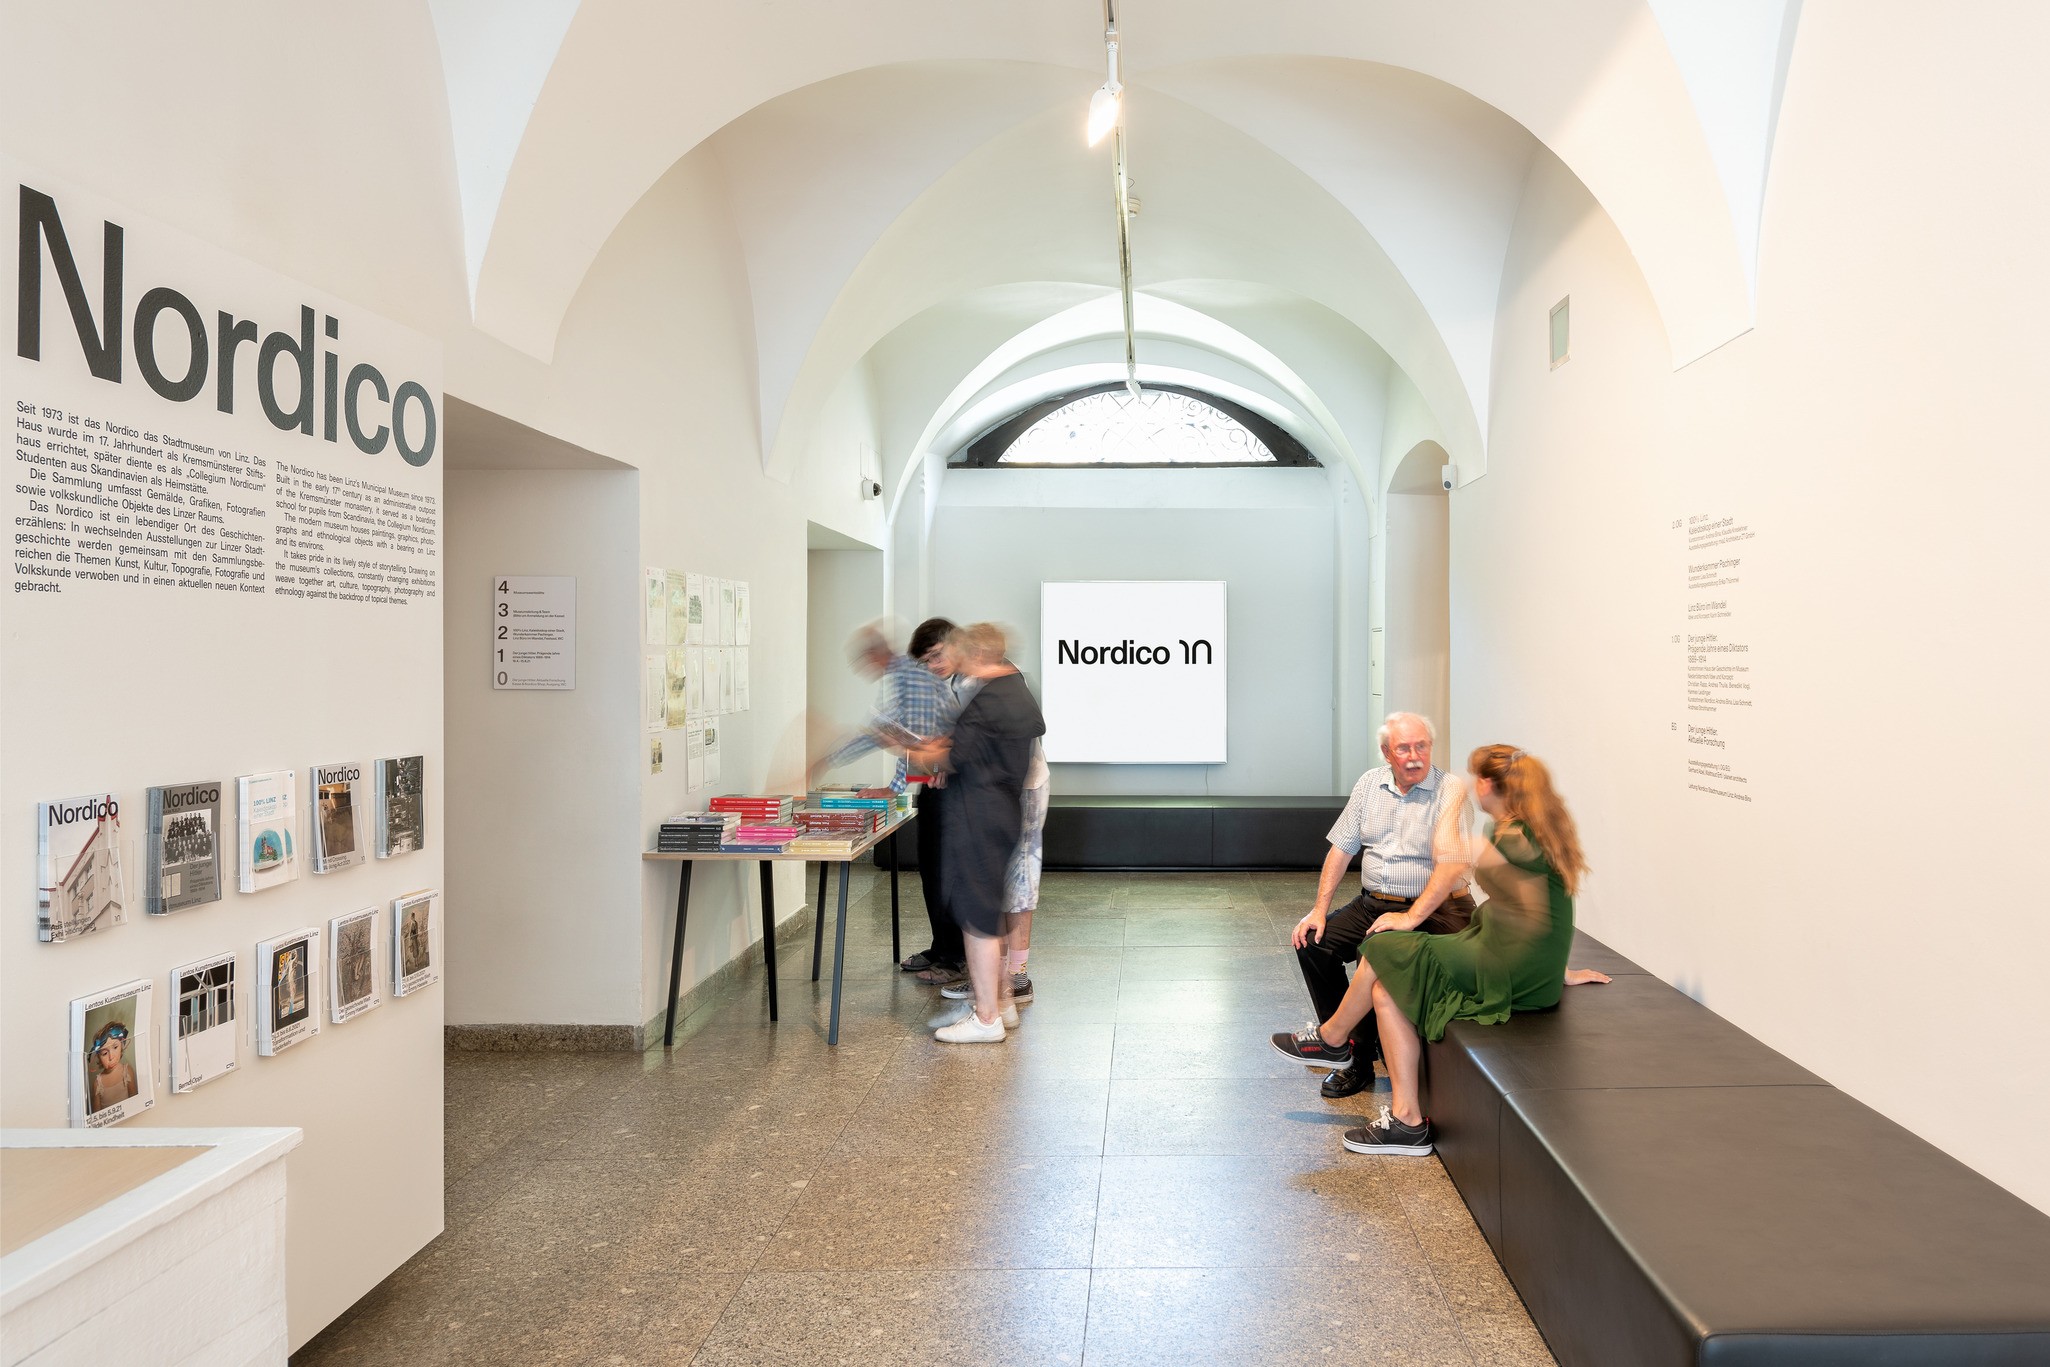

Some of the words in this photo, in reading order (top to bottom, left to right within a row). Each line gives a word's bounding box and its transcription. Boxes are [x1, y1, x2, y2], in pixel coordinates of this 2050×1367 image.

[17, 183, 437, 467] Nordico
[16, 400, 36, 416] Seit
[41, 407, 63, 422] 1973
[68, 412, 80, 426] ist
[84, 416, 101, 430] das
[105, 421, 140, 439] Nordico
[143, 430, 159, 443] das
[162, 434, 215, 456] Stadtmuseum
[218, 450, 232, 459] von
[234, 451, 250, 464] Linz.
[253, 455, 267, 468] Das
[16, 416, 43, 433] Haus
[47, 426, 78, 440] wurde
[82, 430, 94, 444] im
[98, 435, 110, 447] 17.
[113, 438, 164, 459] Jahrhundert
[166, 450, 179, 462] als
[182, 452, 243, 475] Kremsmünsterer
[245, 466, 266, 480] Stifts-
[16, 432, 41, 449] haus
[46, 441, 89, 459] errichtet,
[93, 450, 122, 464] später
[126, 455, 153, 471] diente
[156, 464, 167, 473] es
[170, 465, 183, 476] als
[15, 448, 67, 469] Studenten
[70, 462, 88, 473] aus
[90, 463, 148, 484] Skandinavien
[150, 475, 163, 487] als
[165, 477, 209, 495] Heimstätte.
[276, 460, 289, 472] The
[290, 464, 315, 478] Nordico
[316, 470, 327, 481] has
[329, 473, 343, 484] been
[361, 480, 386, 494] Municipal
[388, 487, 409, 498] Museum
[411, 493, 423, 502] since
[15, 484, 46, 497] sowie
[49, 488, 119, 508] volkskundliche
[121, 498, 154, 514] Objekte
[155, 504, 171, 516] des
[173, 506, 196, 520] Linzer
[198, 510, 225, 524] Raums.
[30, 467, 47, 481] Die
[52, 471, 103, 493] Sammlung
[107, 483, 142, 497] umfasst
[146, 488, 186, 506] Gemälde,
[189, 495, 223, 512] Grafiken,
[226, 501, 266, 518] Fotografien
[276, 473, 290, 485] Built
[293, 477, 299, 486] in
[302, 480, 312, 490] the
[315, 484, 330, 495] early
[342, 490, 362, 502] century
[383, 498, 416, 511] administrative
[418, 506, 436, 515] outpost
[276, 486, 283, 495] of
[285, 488, 296, 498] the
[299, 490, 342, 507] Kremsmünster
[382, 509, 399, 518] served
[416, 514, 436, 527] boarding
[29, 499, 49, 514] Das
[55, 503, 94, 520] Nordico
[99, 509, 111, 522] ist
[116, 513, 130, 524] ein
[135, 515, 180, 533] lebendiger
[183, 522, 197, 534] Ort
[201, 525, 215, 536] des
[219, 527, 265, 543] Geschichten-
[498, 581, 509, 594] 4
[498, 603, 509, 617] 3
[498, 626, 508, 640] 2
[497, 649, 503, 662] 1
[1058, 640, 1170, 664] Nordico
[497, 672, 508, 685] 0
[318, 766, 360, 785] Nordico
[49, 799, 119, 826] Nordico
[163, 786, 219, 809] Nordico
[85, 1000, 103, 1010] Lentos
[104, 988, 140, 1003] Kunstmuseum
[141, 984, 152, 992] Linz
[104, 1112, 125, 1126] Kindheit
